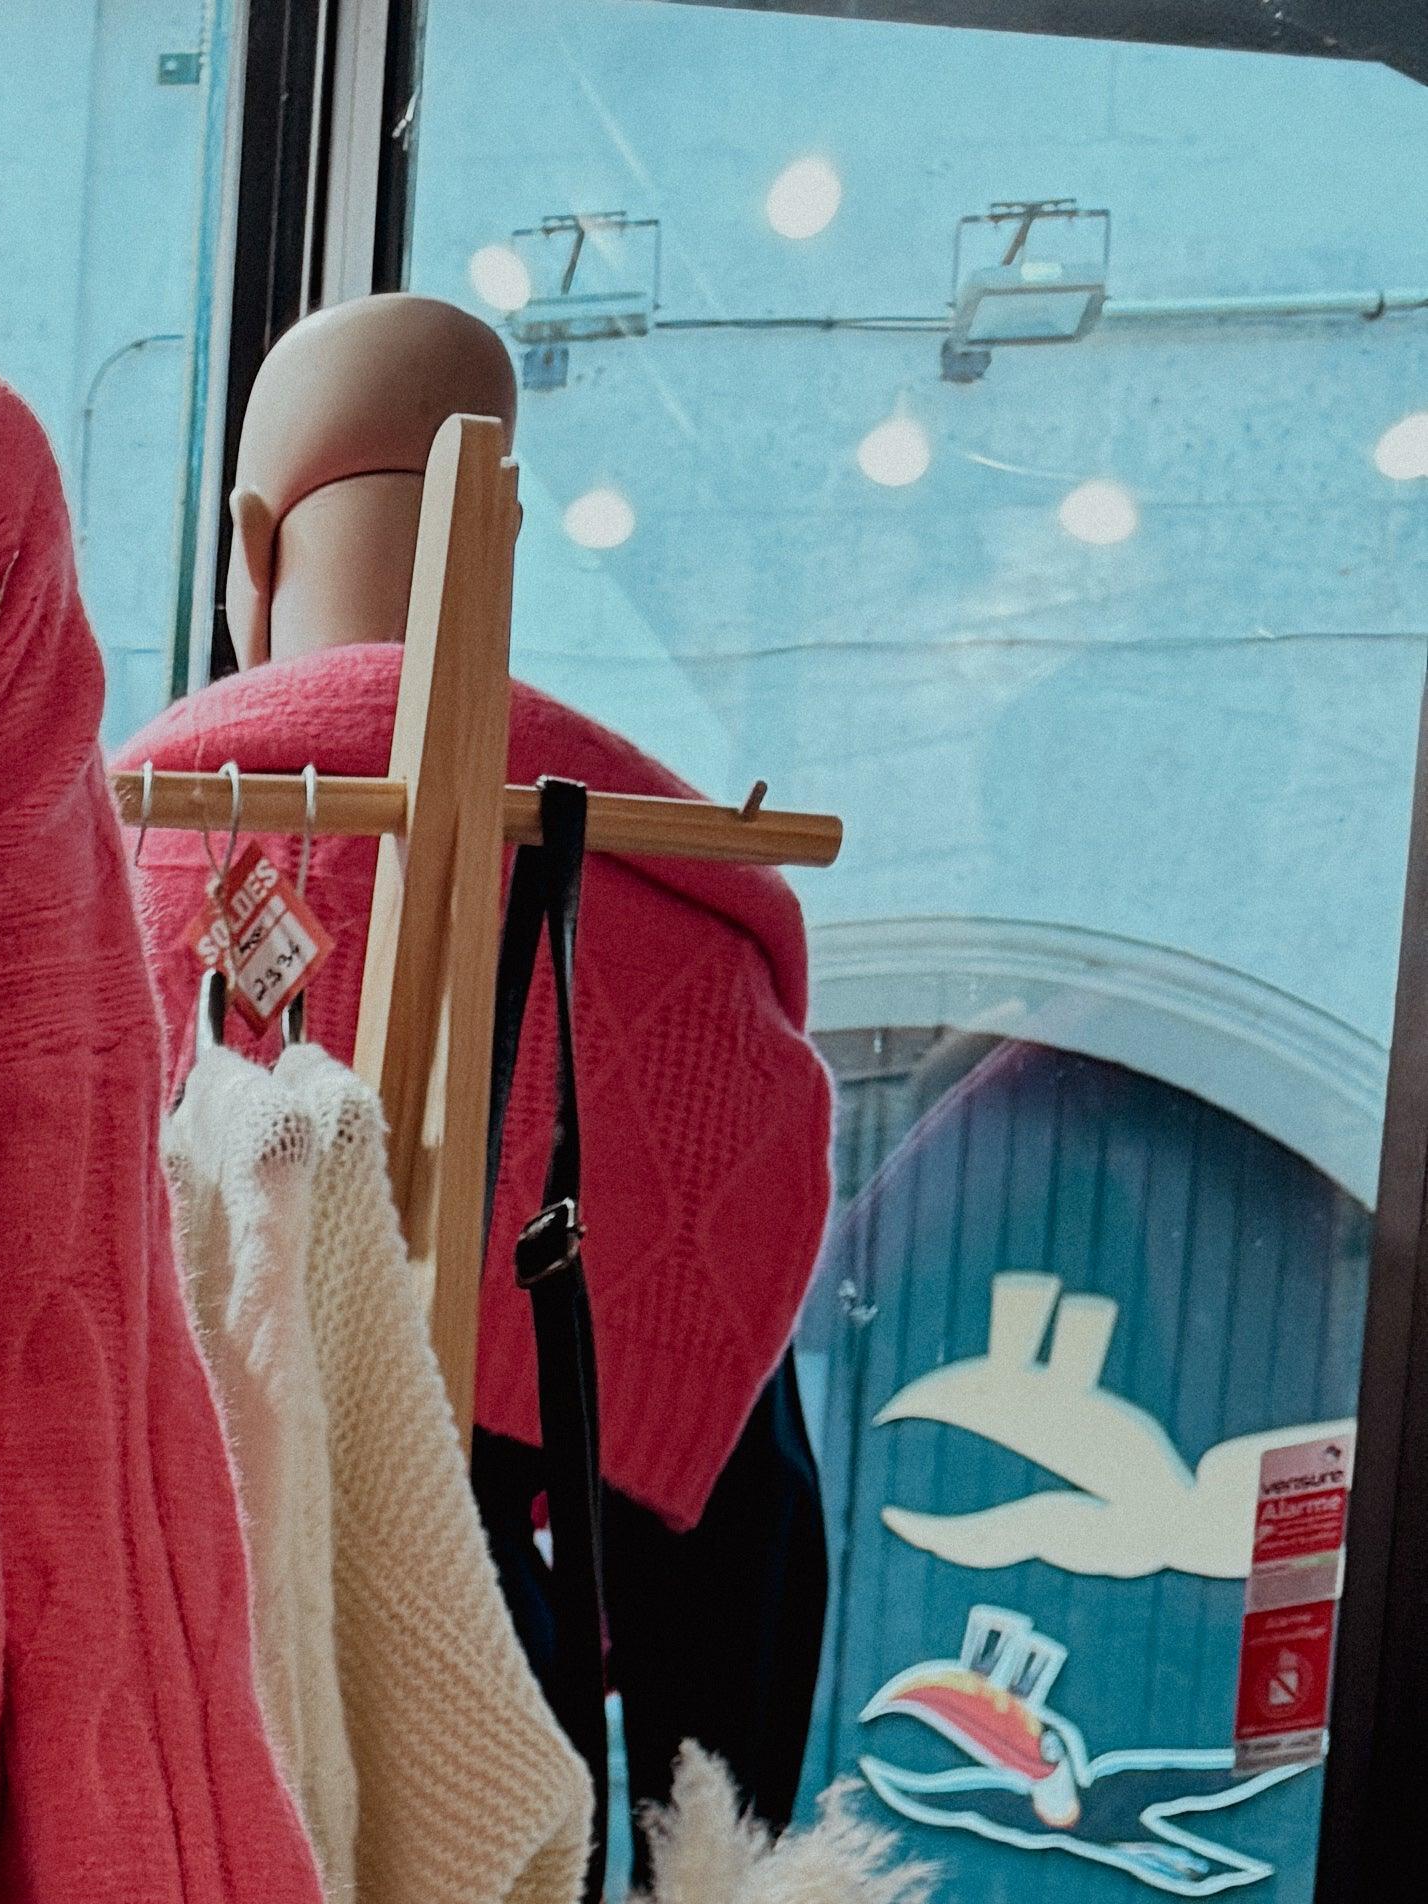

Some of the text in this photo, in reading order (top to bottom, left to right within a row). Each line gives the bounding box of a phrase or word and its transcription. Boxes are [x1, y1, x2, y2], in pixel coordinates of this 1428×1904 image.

[197, 858, 279, 966] SOLDES
[1260, 1470, 1344, 1495] verisure
[1259, 1496, 1342, 1522] Alarme
